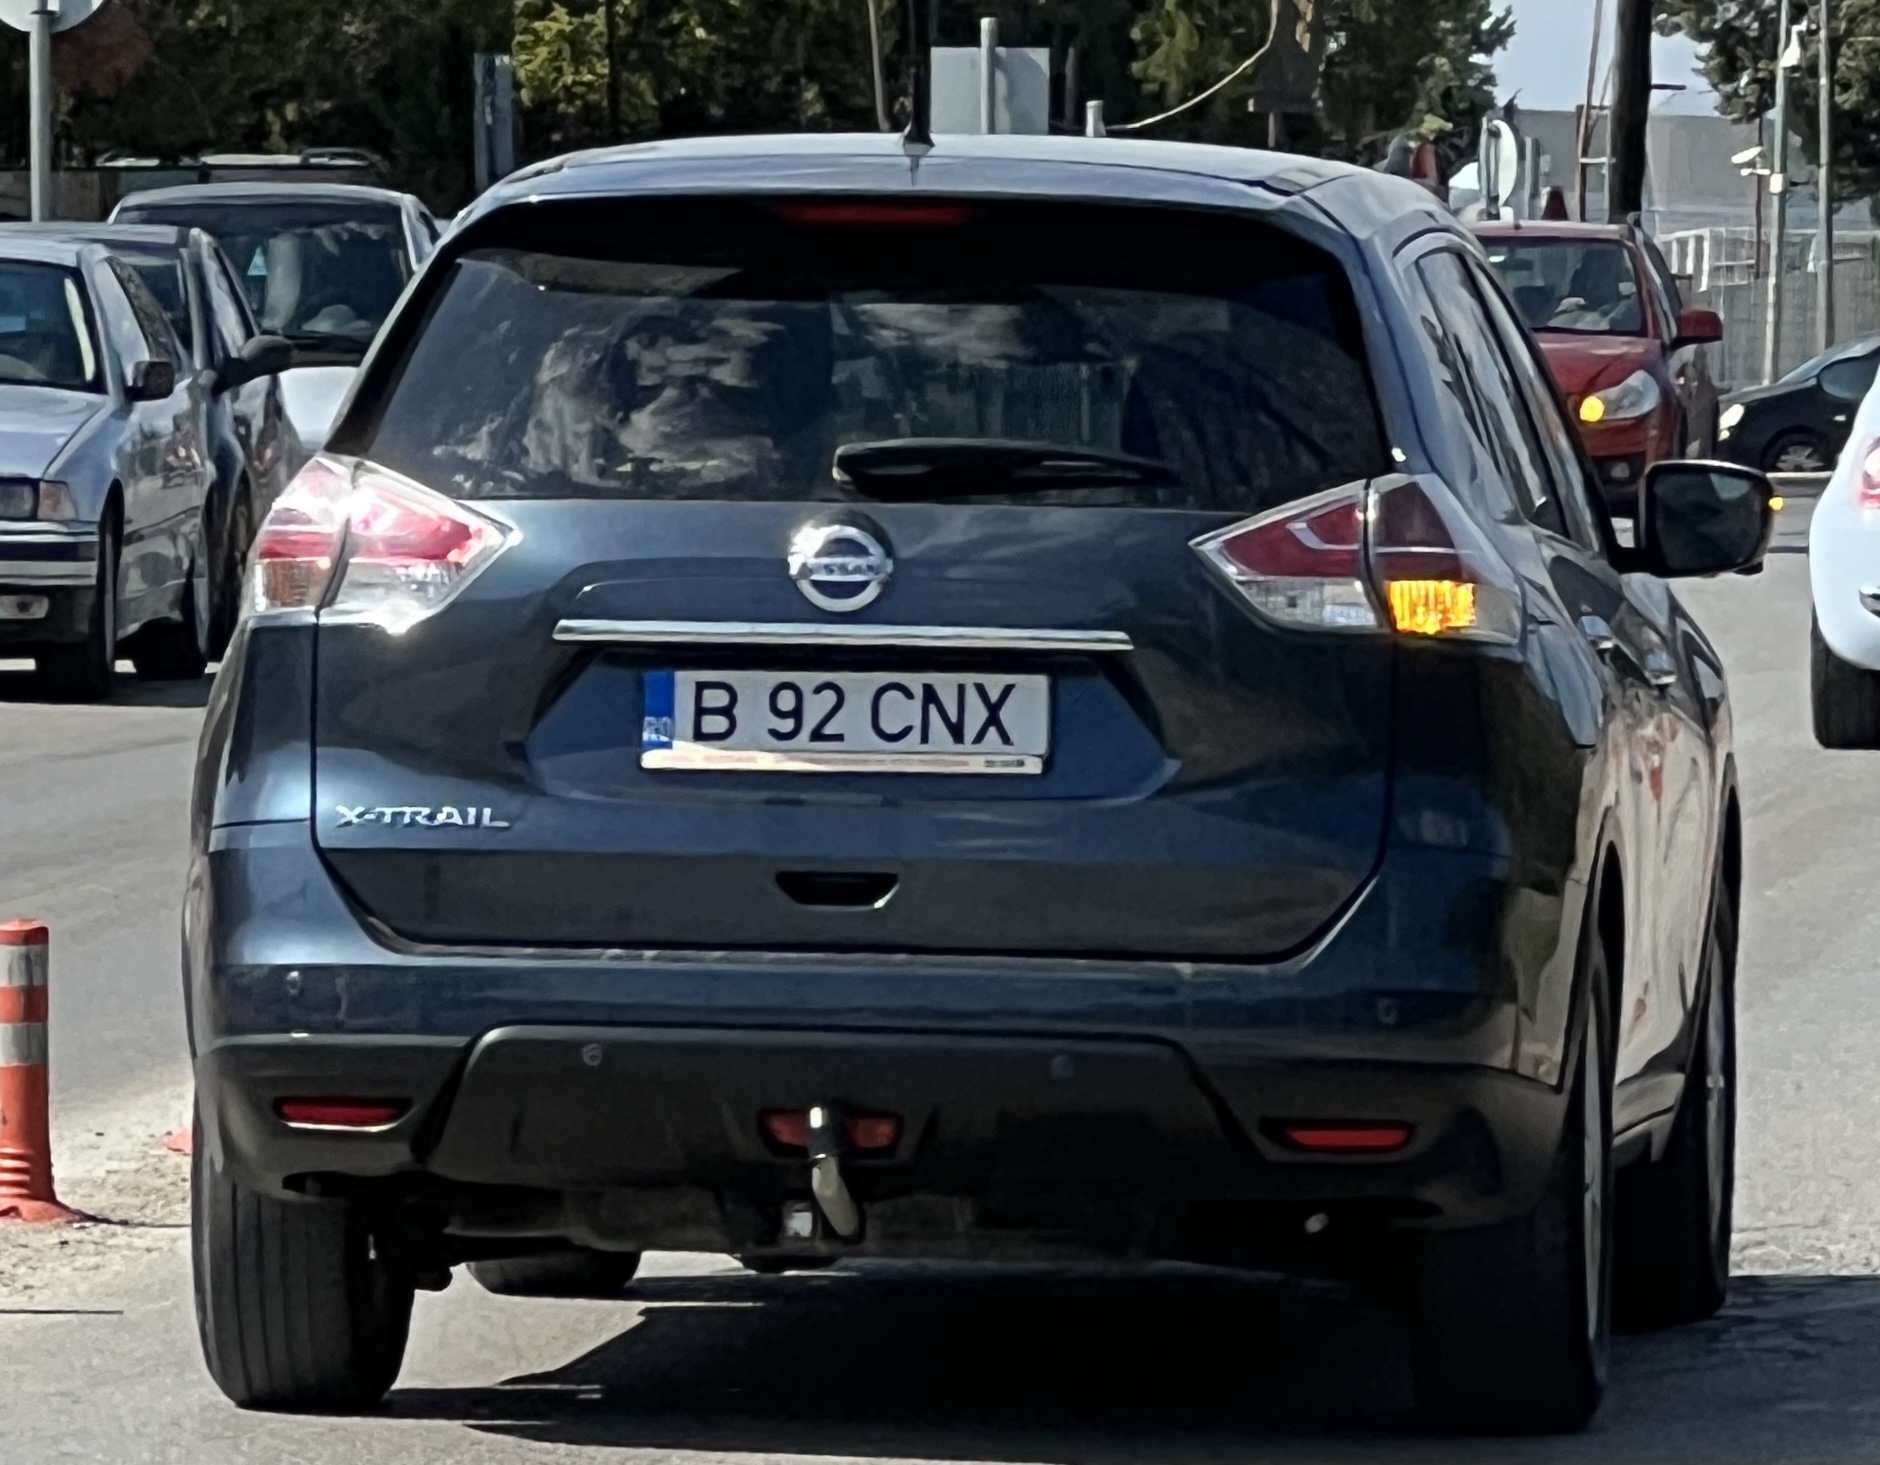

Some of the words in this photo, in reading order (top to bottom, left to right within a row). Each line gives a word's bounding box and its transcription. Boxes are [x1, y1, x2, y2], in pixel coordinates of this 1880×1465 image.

[692, 680, 739, 742] B
[767, 680, 846, 743] 92
[870, 681, 1017, 746] CNX
[334, 804, 511, 829] X-TRAIL
